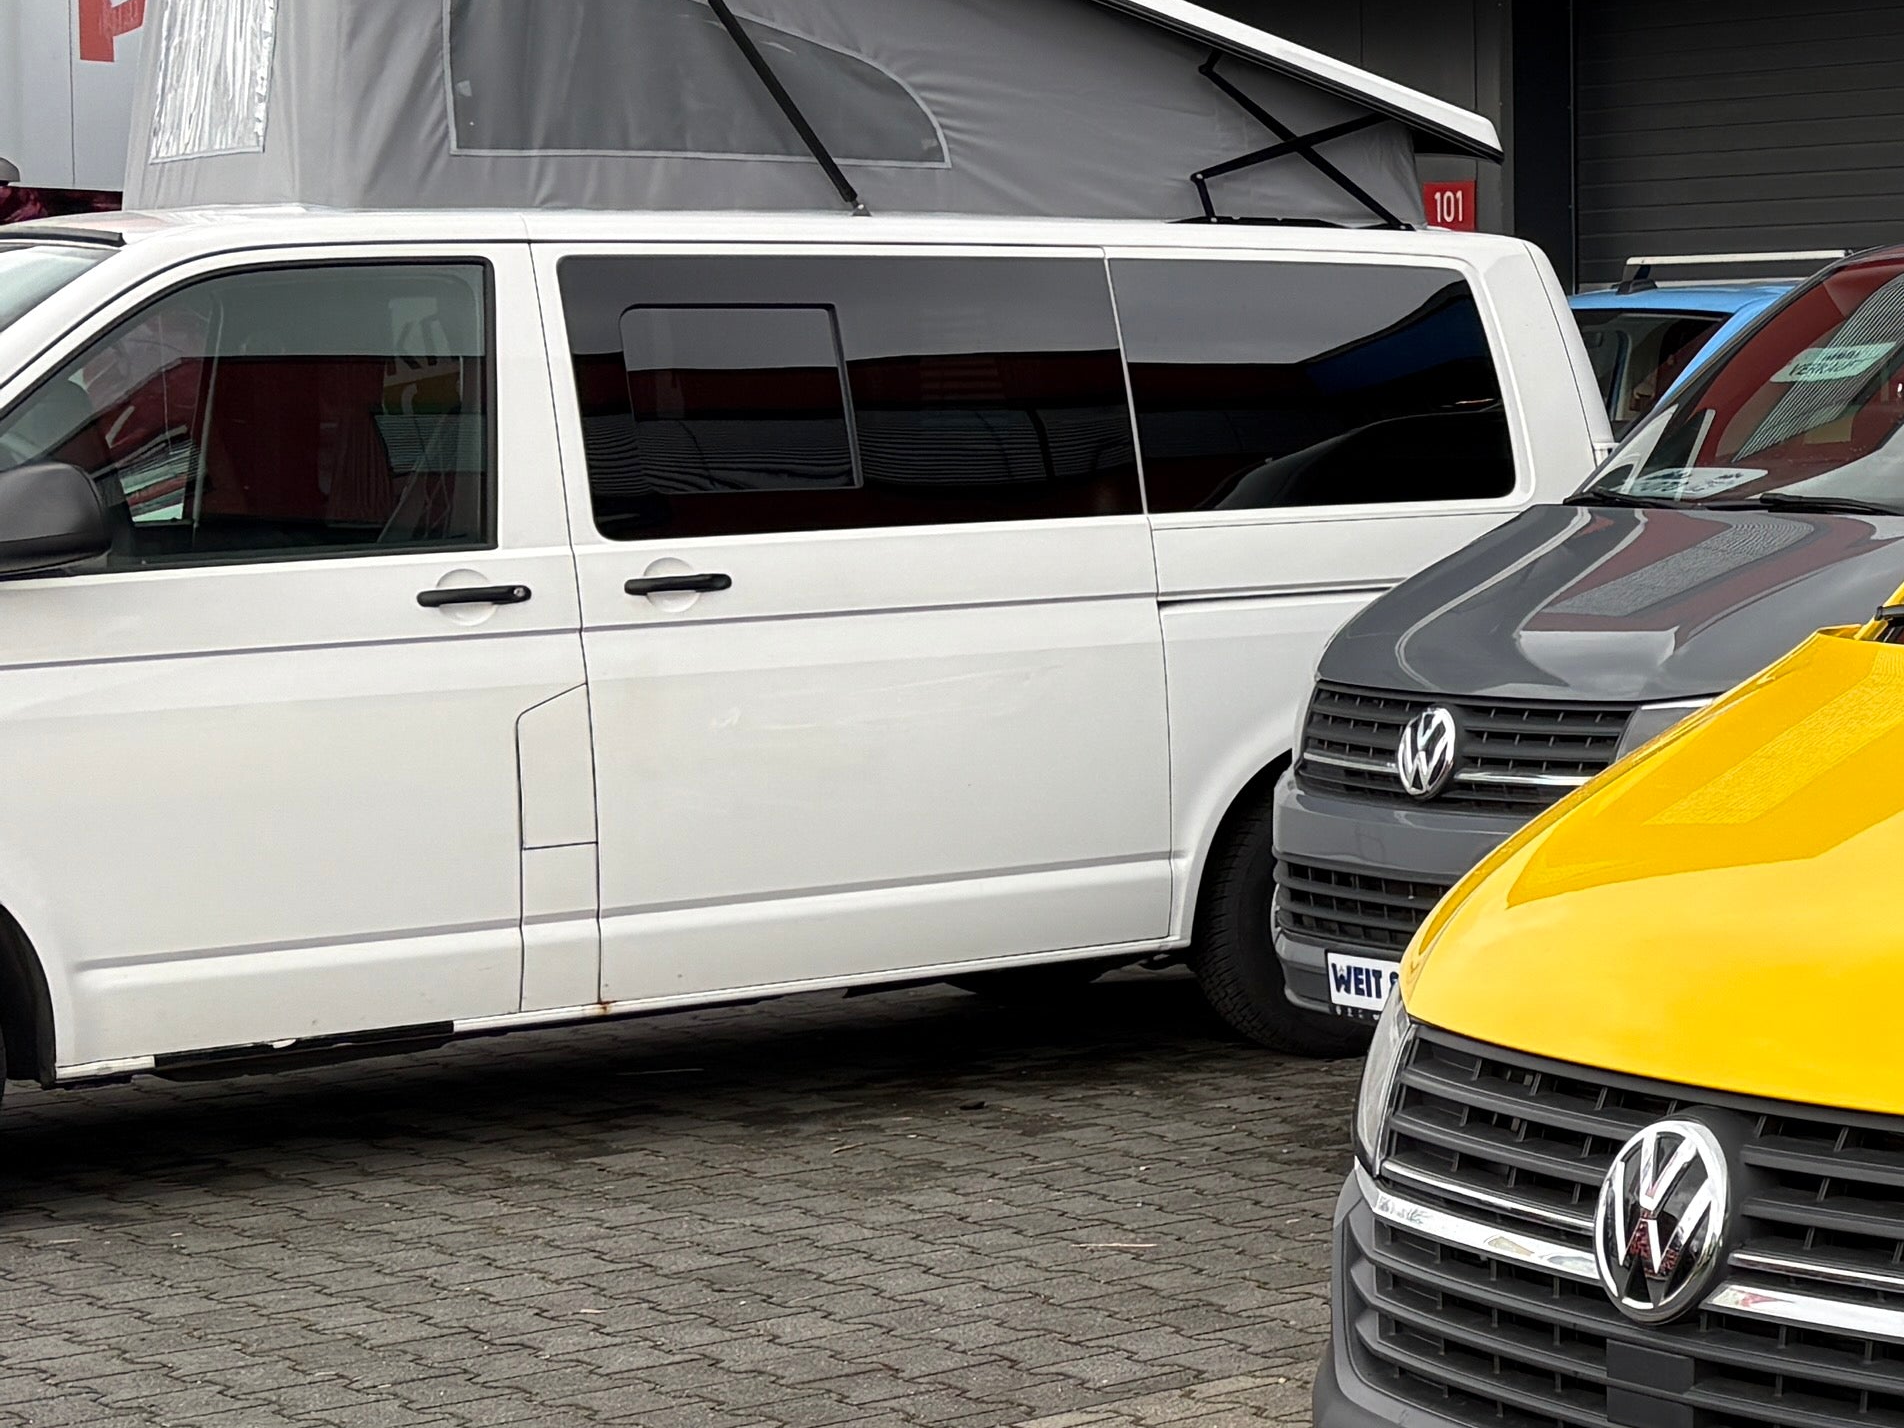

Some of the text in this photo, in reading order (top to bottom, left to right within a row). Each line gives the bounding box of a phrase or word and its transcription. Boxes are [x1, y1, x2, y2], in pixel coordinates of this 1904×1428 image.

[1434, 189, 1464, 223] 101
[1398, 708, 1456, 800] VW
[1331, 962, 1382, 999] WEIT
[1593, 1119, 1731, 1325] VW
